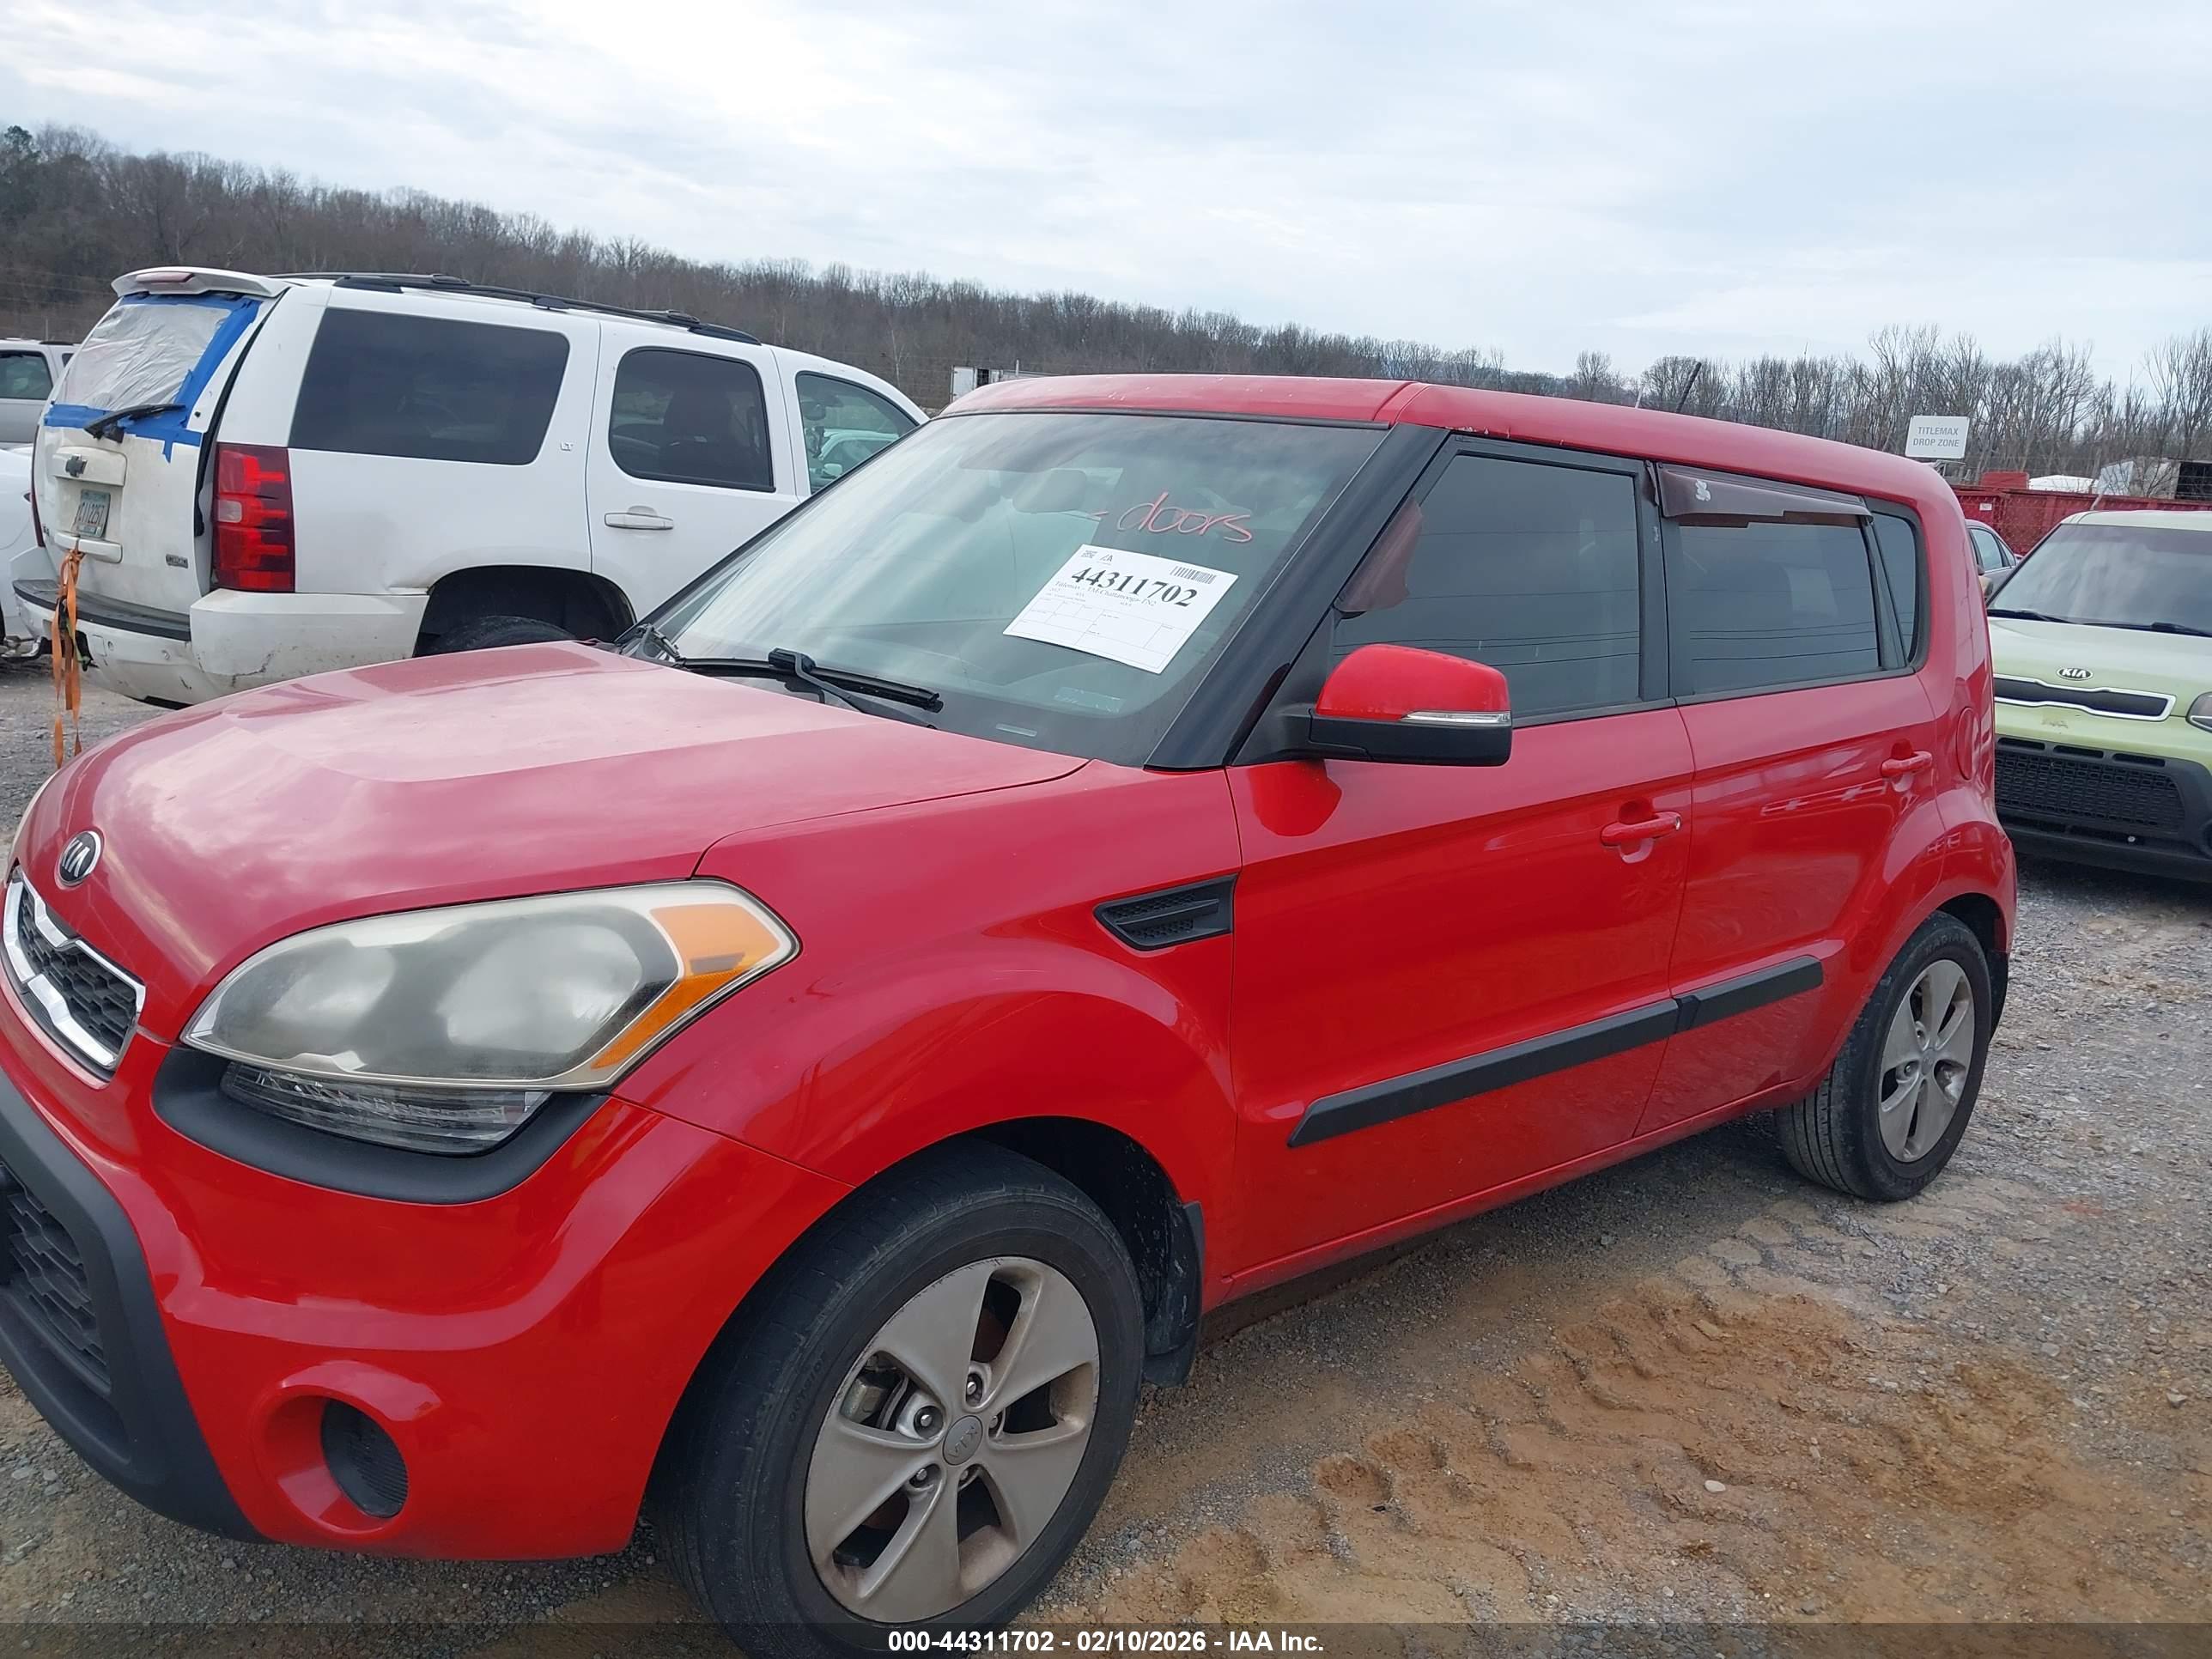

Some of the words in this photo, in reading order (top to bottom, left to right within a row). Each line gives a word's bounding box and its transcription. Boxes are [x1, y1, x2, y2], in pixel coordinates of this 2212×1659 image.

[1913, 438, 1936, 447] DROP
[1937, 439, 1960, 447] ZONE
[1917, 427, 1959, 435] TITLEMAX
[1117, 492, 1252, 543] doors
[1071, 567, 1198, 608] 44311702
[62, 839, 91, 878] KIA
